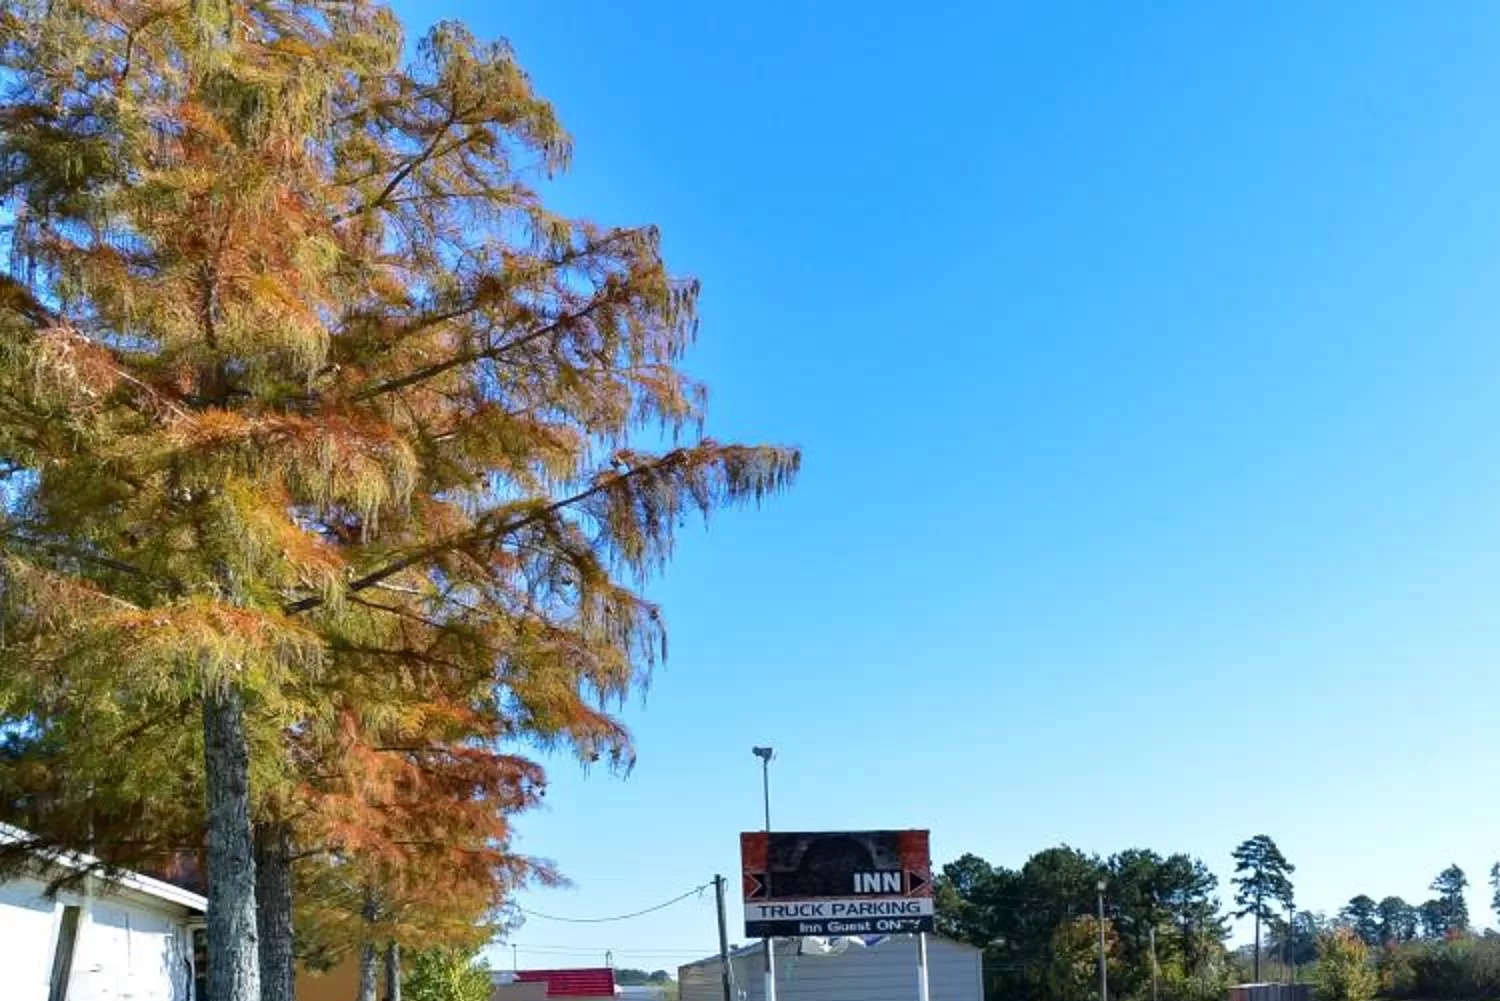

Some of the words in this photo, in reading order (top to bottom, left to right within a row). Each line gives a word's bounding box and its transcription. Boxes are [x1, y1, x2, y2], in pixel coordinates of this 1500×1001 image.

[853, 872, 900, 893] INN
[760, 905, 823, 917] TRUCK
[831, 902, 921, 915] PARKING
[829, 921, 872, 931] Guest
